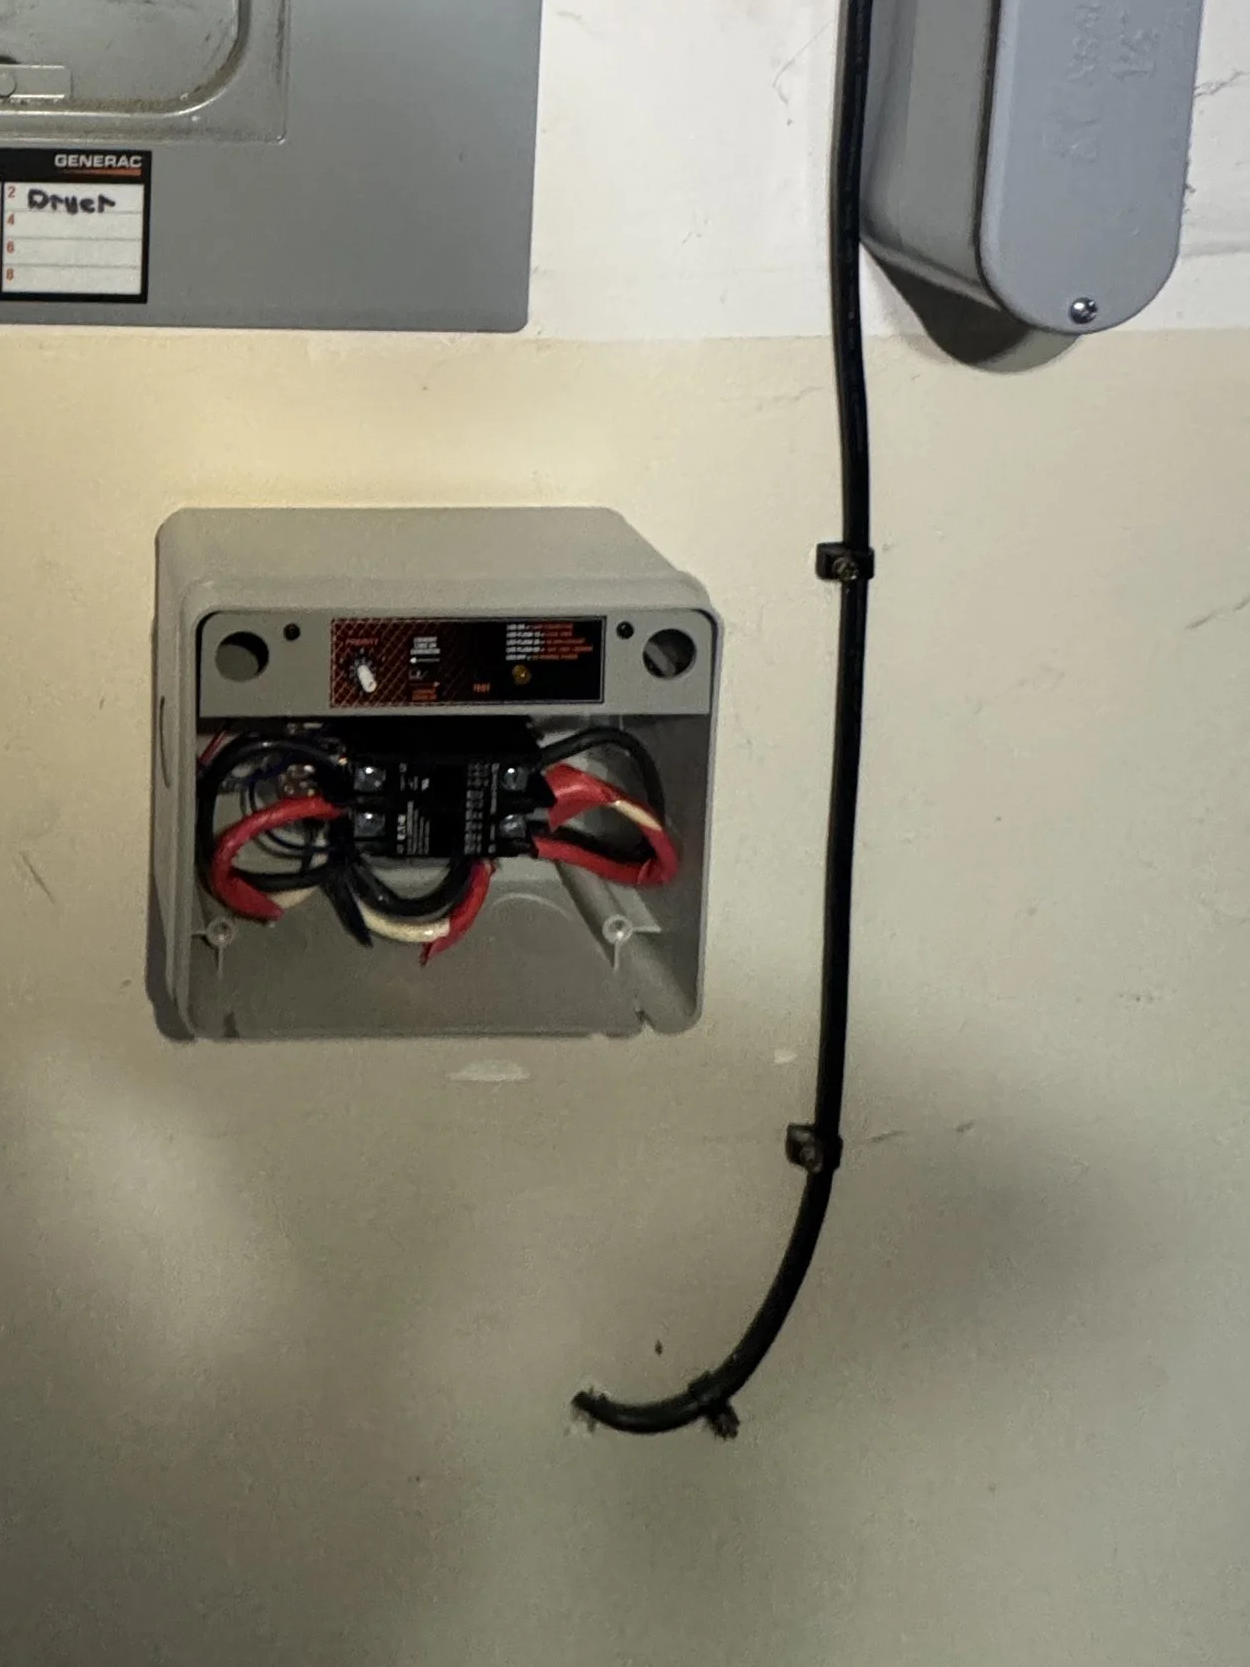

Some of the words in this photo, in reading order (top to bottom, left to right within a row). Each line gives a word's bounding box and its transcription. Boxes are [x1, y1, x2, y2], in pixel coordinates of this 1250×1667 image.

[54, 154, 142, 169] GENERAC
[7, 186, 16, 199] 2
[27, 188, 117, 215] Dryer
[6, 213, 15, 226] 4
[6, 240, 16, 253] 6
[6, 268, 15, 281] 8
